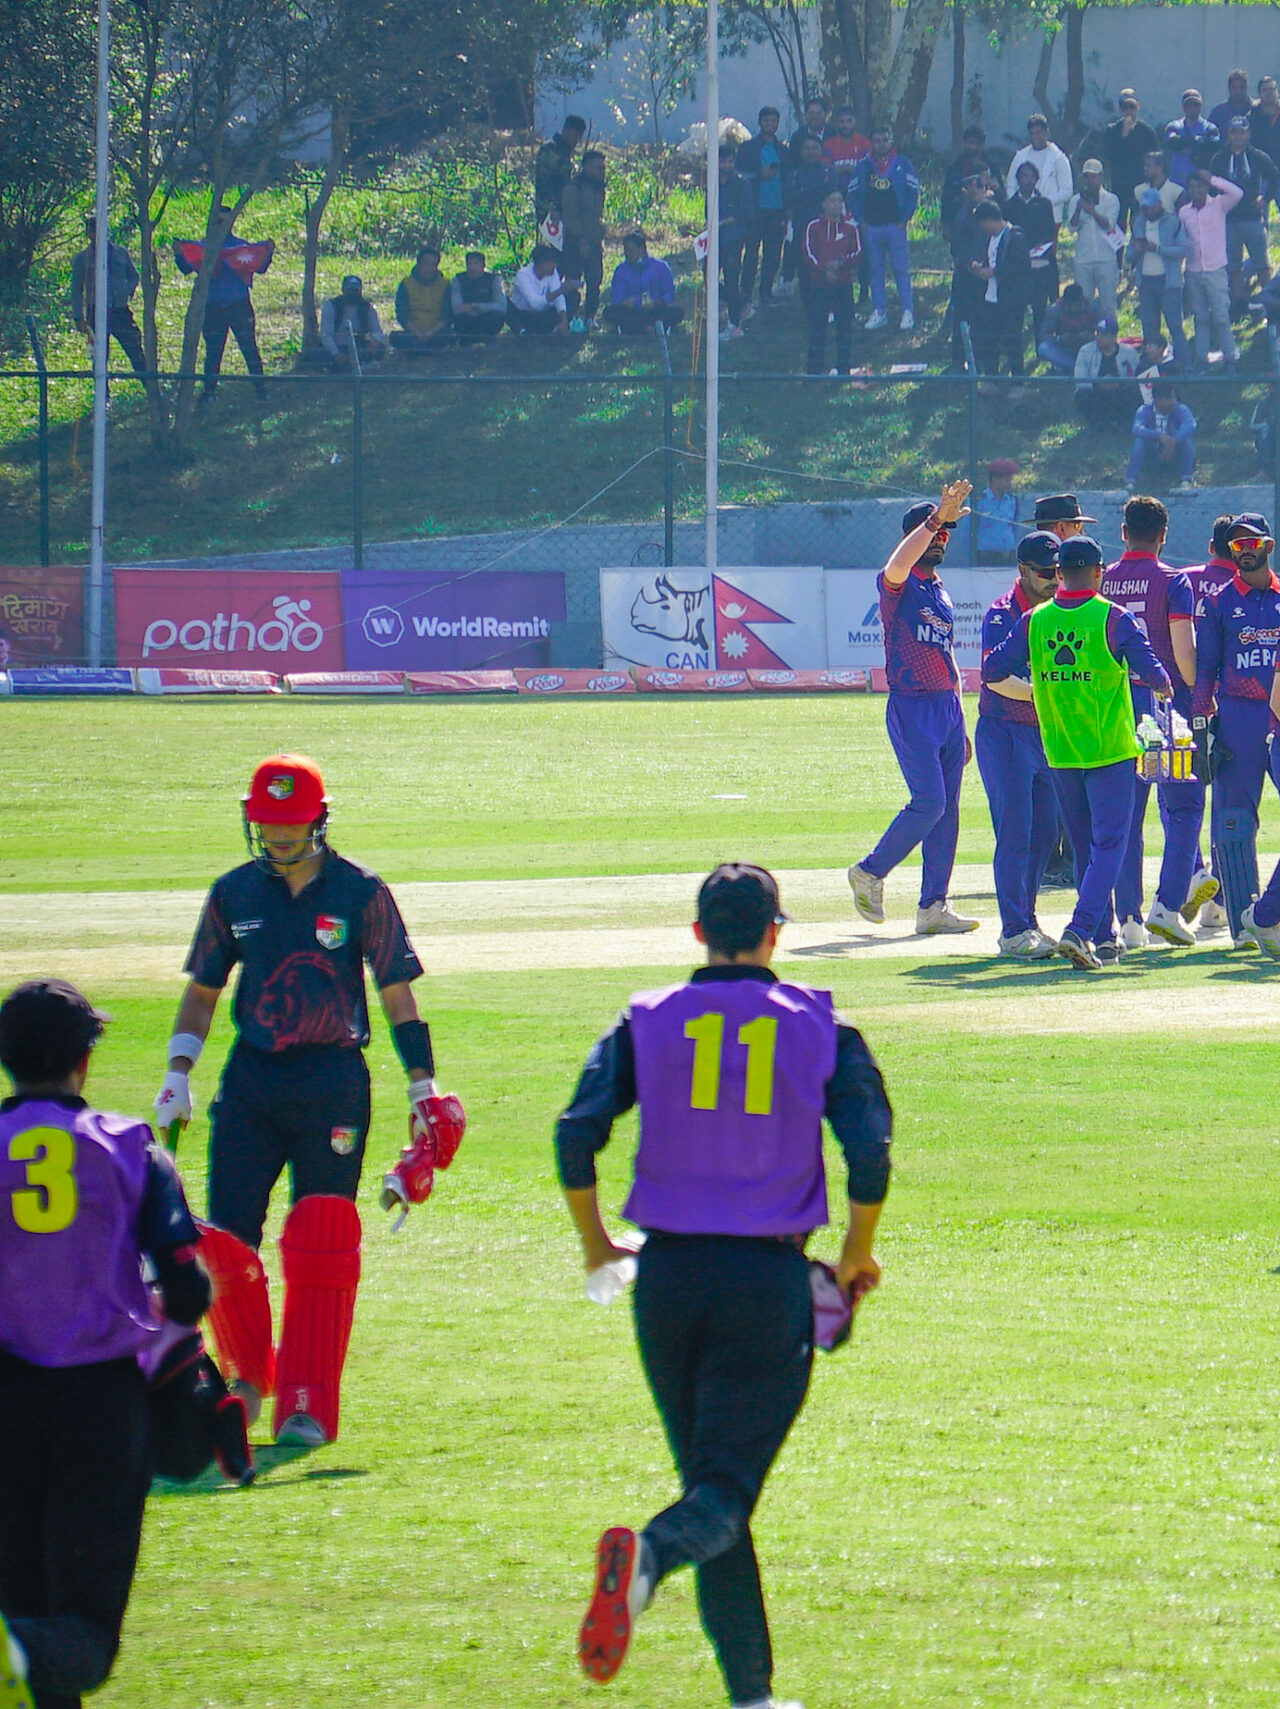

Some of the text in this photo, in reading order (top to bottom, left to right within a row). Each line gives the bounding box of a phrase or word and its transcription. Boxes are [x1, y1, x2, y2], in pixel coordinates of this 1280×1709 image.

[1102, 579, 1149, 596] GULSHAN
[952, 600, 982, 610] each
[412, 616, 550, 637] WorldRemit
[142, 613, 323, 658] pathao
[665, 652, 709, 669] CAN
[531, 675, 561, 691] Real
[592, 675, 622, 691] Real
[1041, 671, 1092, 682] KELME
[684, 1013, 778, 1115] 11
[8, 1126, 77, 1234] 3
